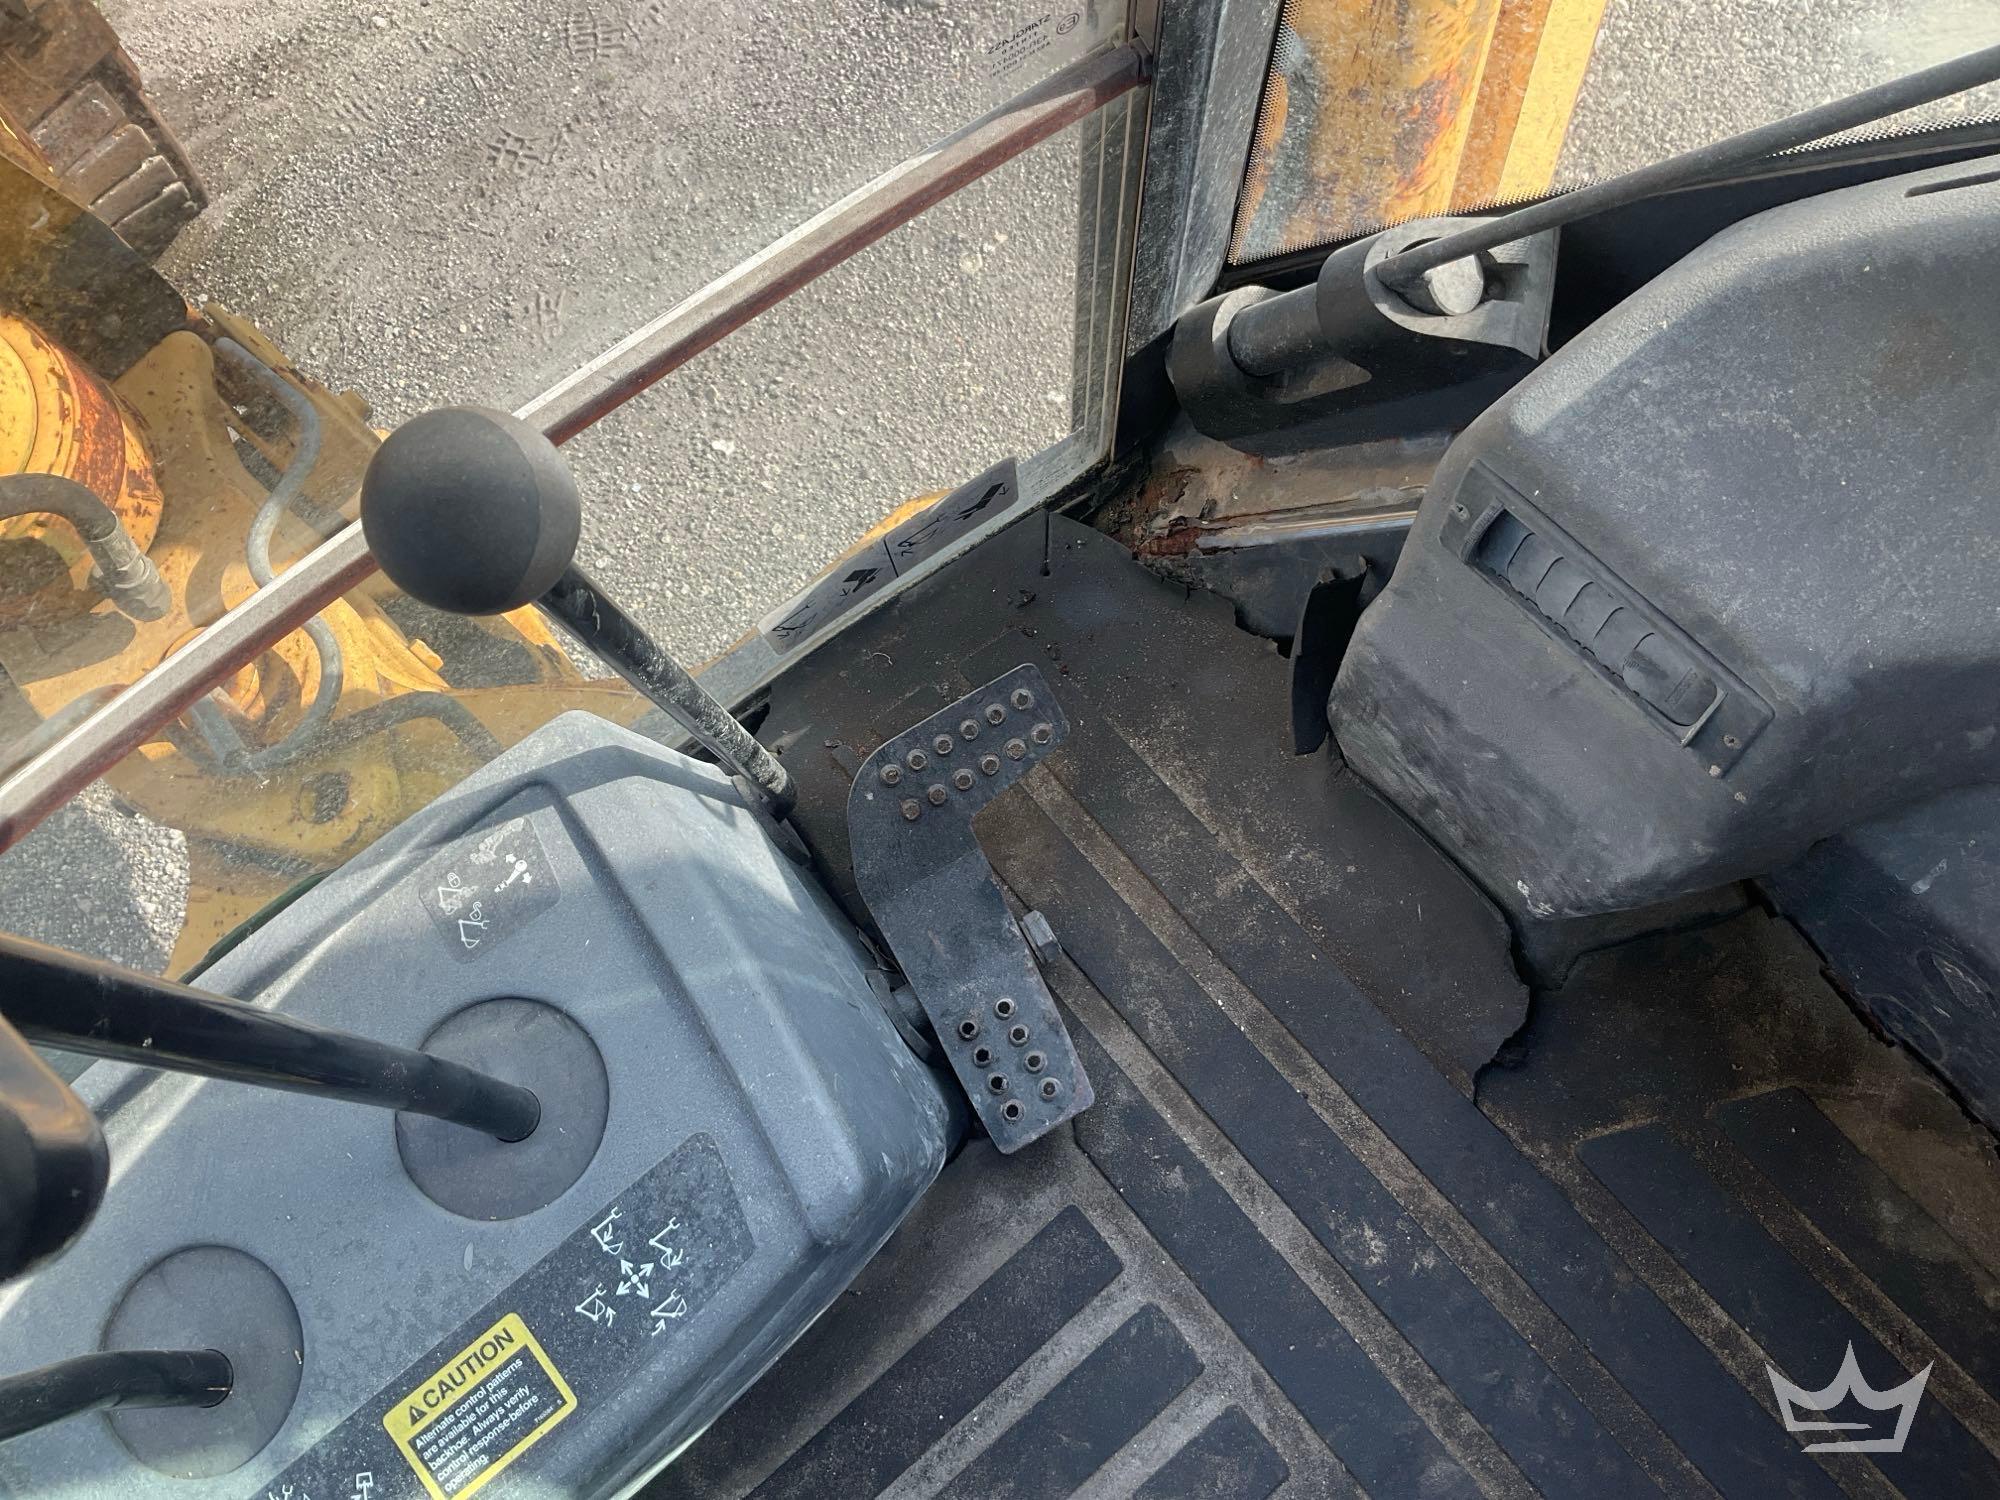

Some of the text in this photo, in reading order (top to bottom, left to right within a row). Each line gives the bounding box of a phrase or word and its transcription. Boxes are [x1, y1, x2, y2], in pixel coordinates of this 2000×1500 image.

[415, 1358, 523, 1450] Alternate control patterns
[422, 1327, 515, 1409] CAUTION
[422, 1386, 508, 1460] are available for this
[428, 1435, 471, 1471] backhoe.
[472, 1407, 505, 1437] Always
[504, 1384, 530, 1411] verify
[437, 1452, 470, 1482] control
[445, 1453, 490, 1492] operating.
